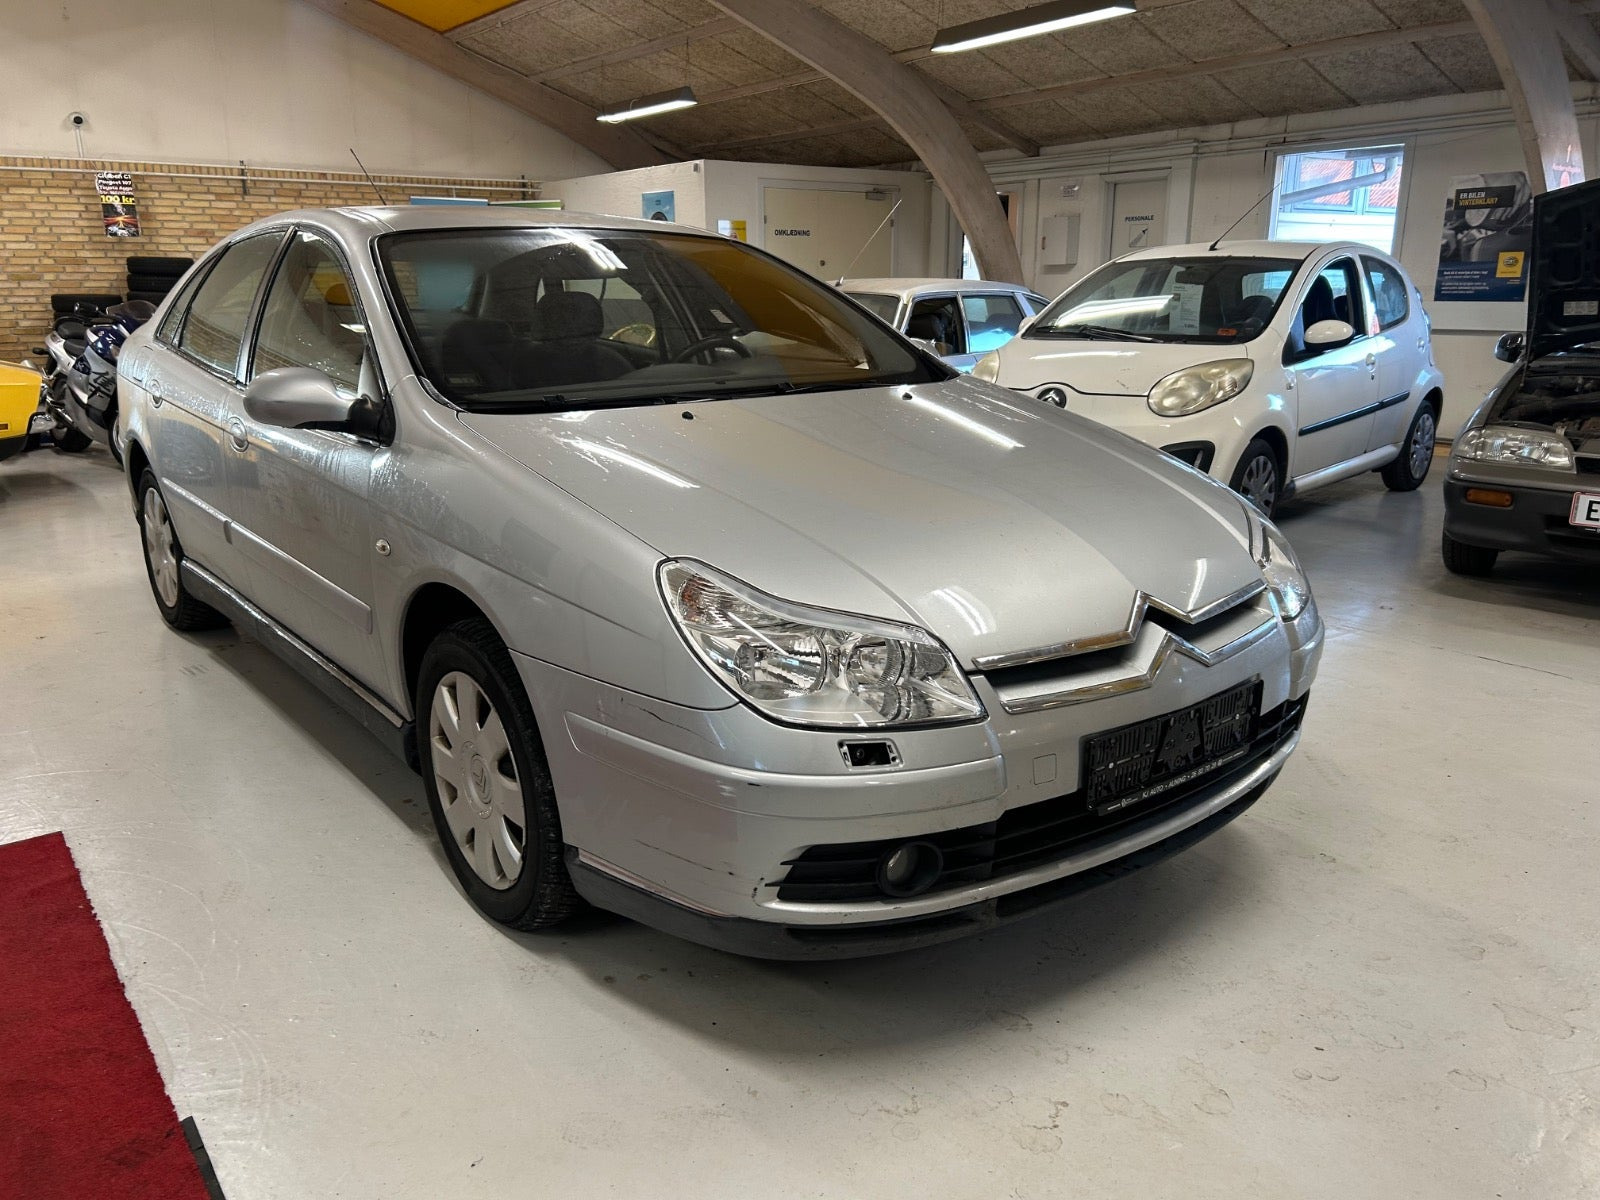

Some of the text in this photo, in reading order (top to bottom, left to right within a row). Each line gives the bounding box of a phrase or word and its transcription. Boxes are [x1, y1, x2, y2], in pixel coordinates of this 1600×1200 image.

[101, 195, 135, 204] 100 kr
[1125, 214, 1155, 222] PERSONALE
[774, 229, 811, 237] OMKLÆDNING
[1585, 499, 1600, 522] E
